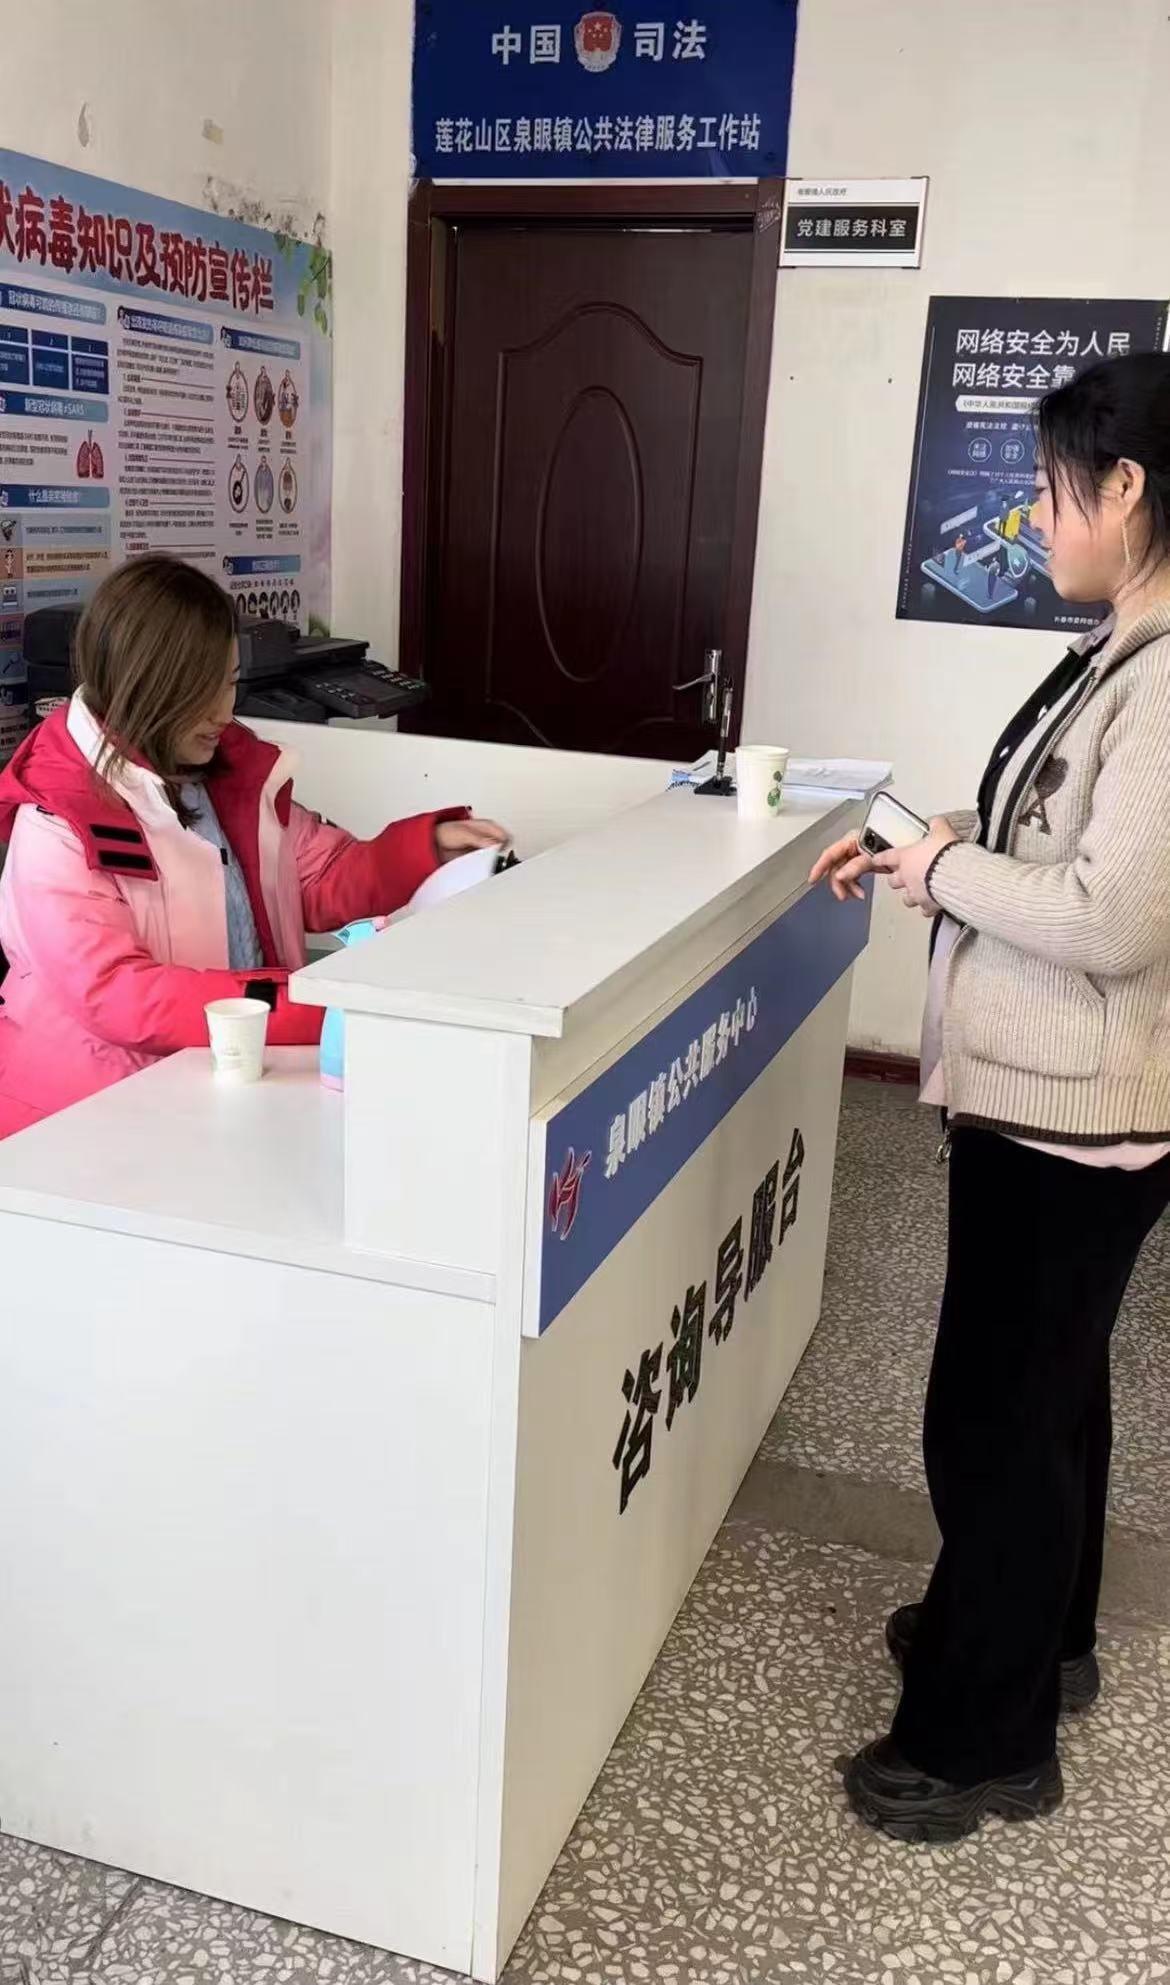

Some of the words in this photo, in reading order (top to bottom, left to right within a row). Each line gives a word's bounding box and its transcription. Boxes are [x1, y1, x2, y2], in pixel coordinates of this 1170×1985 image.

[491, 24, 562, 65] 中国
[634, 19, 708, 62] 司法
[434, 113, 761, 154] 莲花山区泉眼镇公共法律服务工作站
[797, 218, 907, 238] 党建服务科室
[955, 328, 1131, 357] 网络安全为人民
[604, 986, 758, 1180] 泉眼镇公共服务中心
[612, 1127, 805, 1516] 咨询导服台
